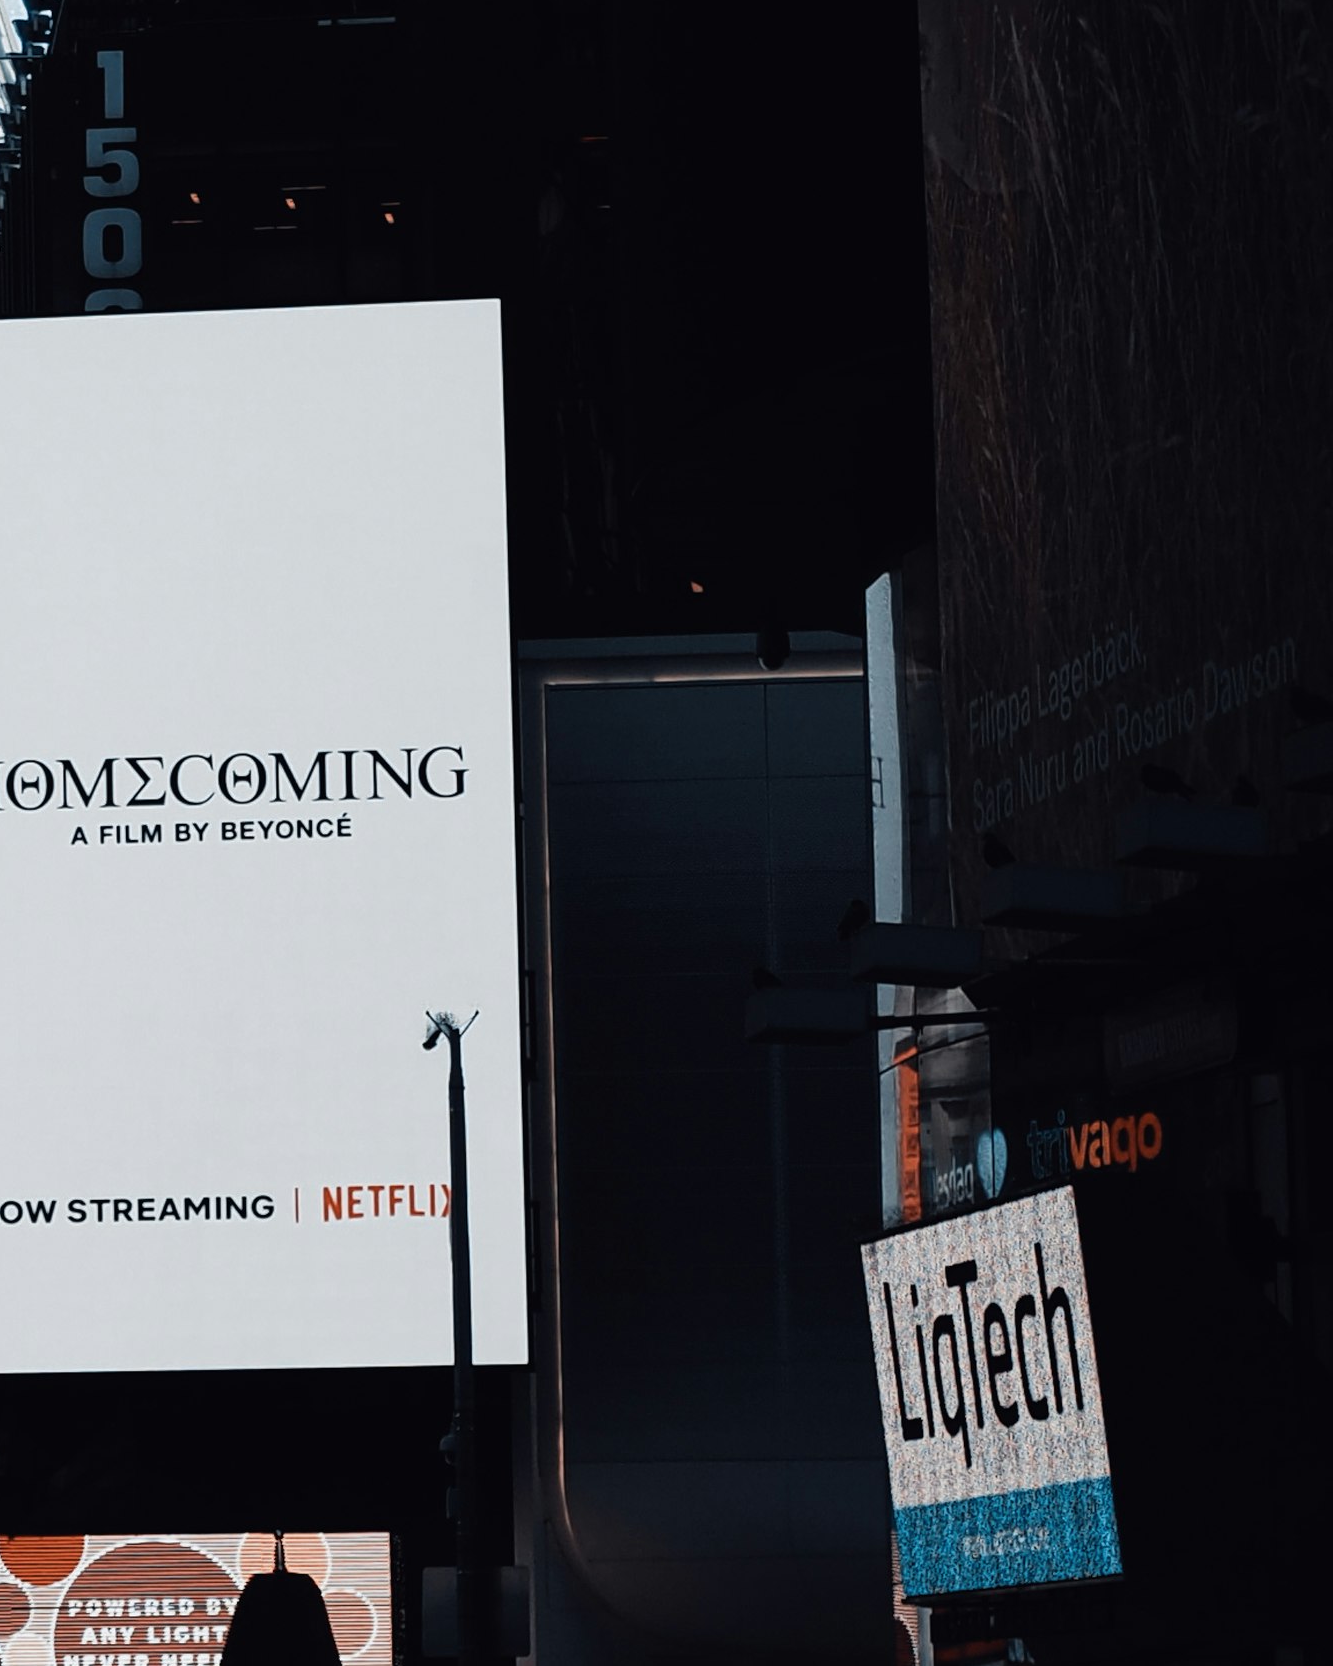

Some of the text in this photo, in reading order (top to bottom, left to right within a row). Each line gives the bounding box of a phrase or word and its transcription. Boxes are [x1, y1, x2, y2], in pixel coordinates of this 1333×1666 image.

[968, 621, 1147, 755] Filippa Lagerbäck,
[973, 636, 1297, 833] Sara Nuru and Rosario Dawson
[71, 813, 352, 845] A FILM BY BEYONCÉ
[1027, 1108, 1163, 1180] trivago
[67, 1195, 275, 1222] STREAMING
[884, 1242, 1084, 1468] LiqTech
[67, 1597, 239, 1617] POWERED BY
[81, 1626, 230, 1646] ANY LIGHT
